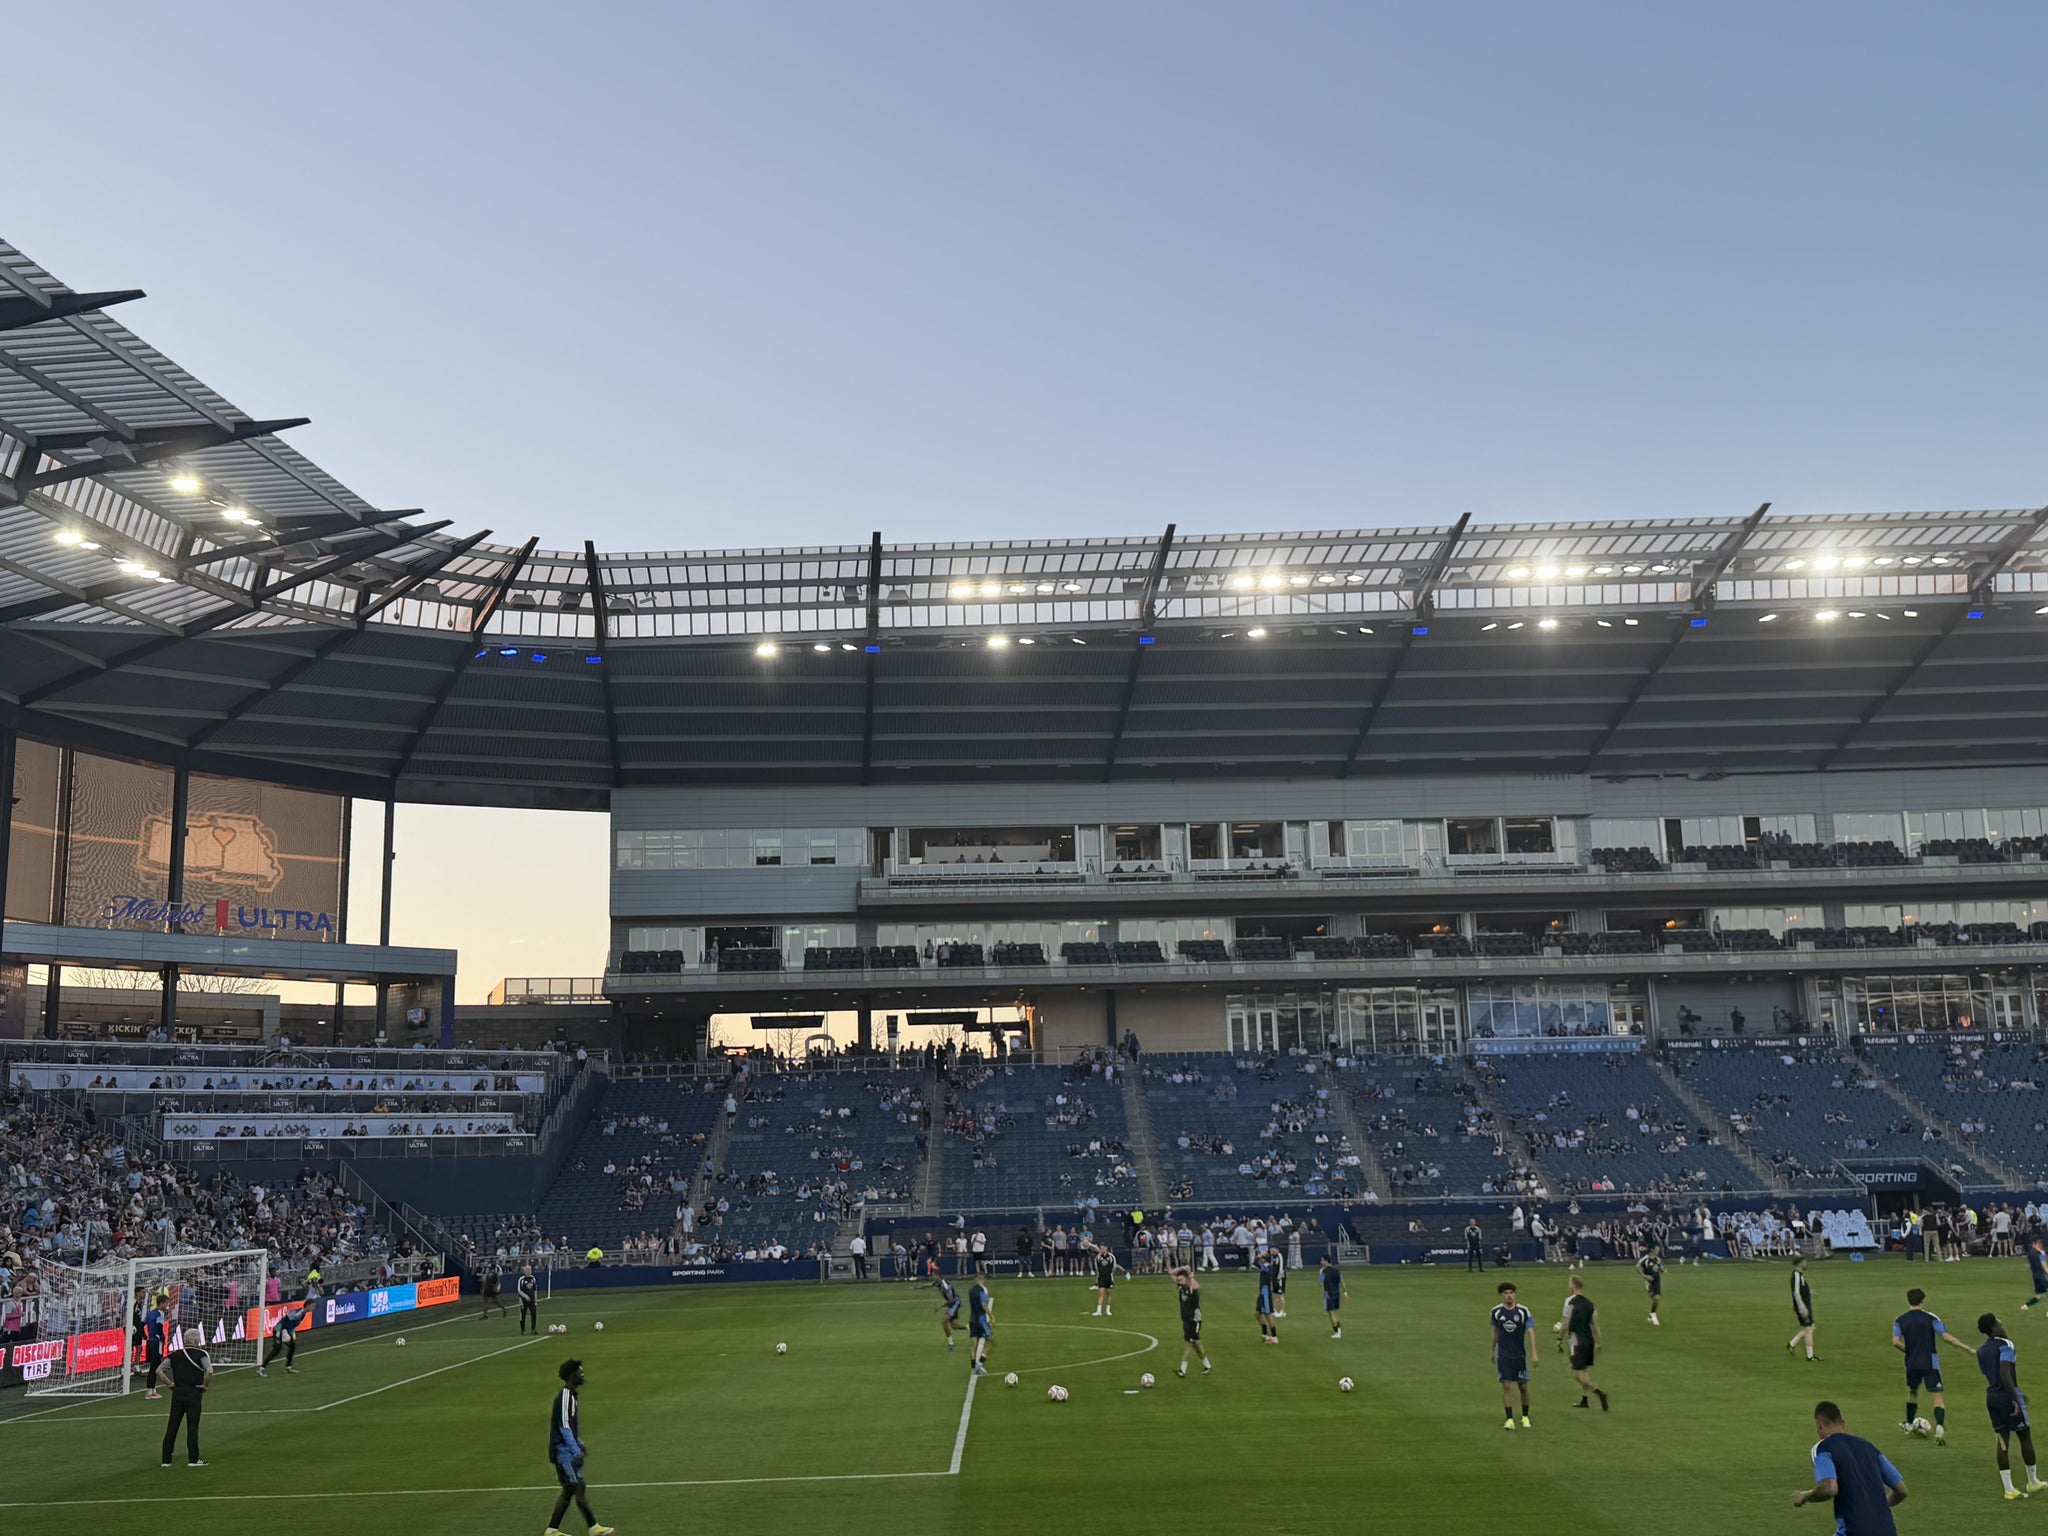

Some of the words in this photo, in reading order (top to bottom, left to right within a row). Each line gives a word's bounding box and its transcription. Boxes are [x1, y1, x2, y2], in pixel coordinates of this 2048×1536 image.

[101, 895, 206, 923] Michelob
[239, 906, 332, 932] ULTRA
[108, 1024, 143, 1033] KICKIN'
[1755, 1039, 1789, 1047] Huhtamaki
[1864, 1036, 1898, 1044] Huhtamaki
[1950, 1034, 1985, 1042] Huhtamaki
[1668, 1040, 1702, 1048] Huhtamaki
[1853, 1172, 1917, 1183] PORTING
[447, 1280, 458, 1295] Tire
[13, 1341, 64, 1366] DISCOUNT
[26, 1363, 48, 1377] TIRE
